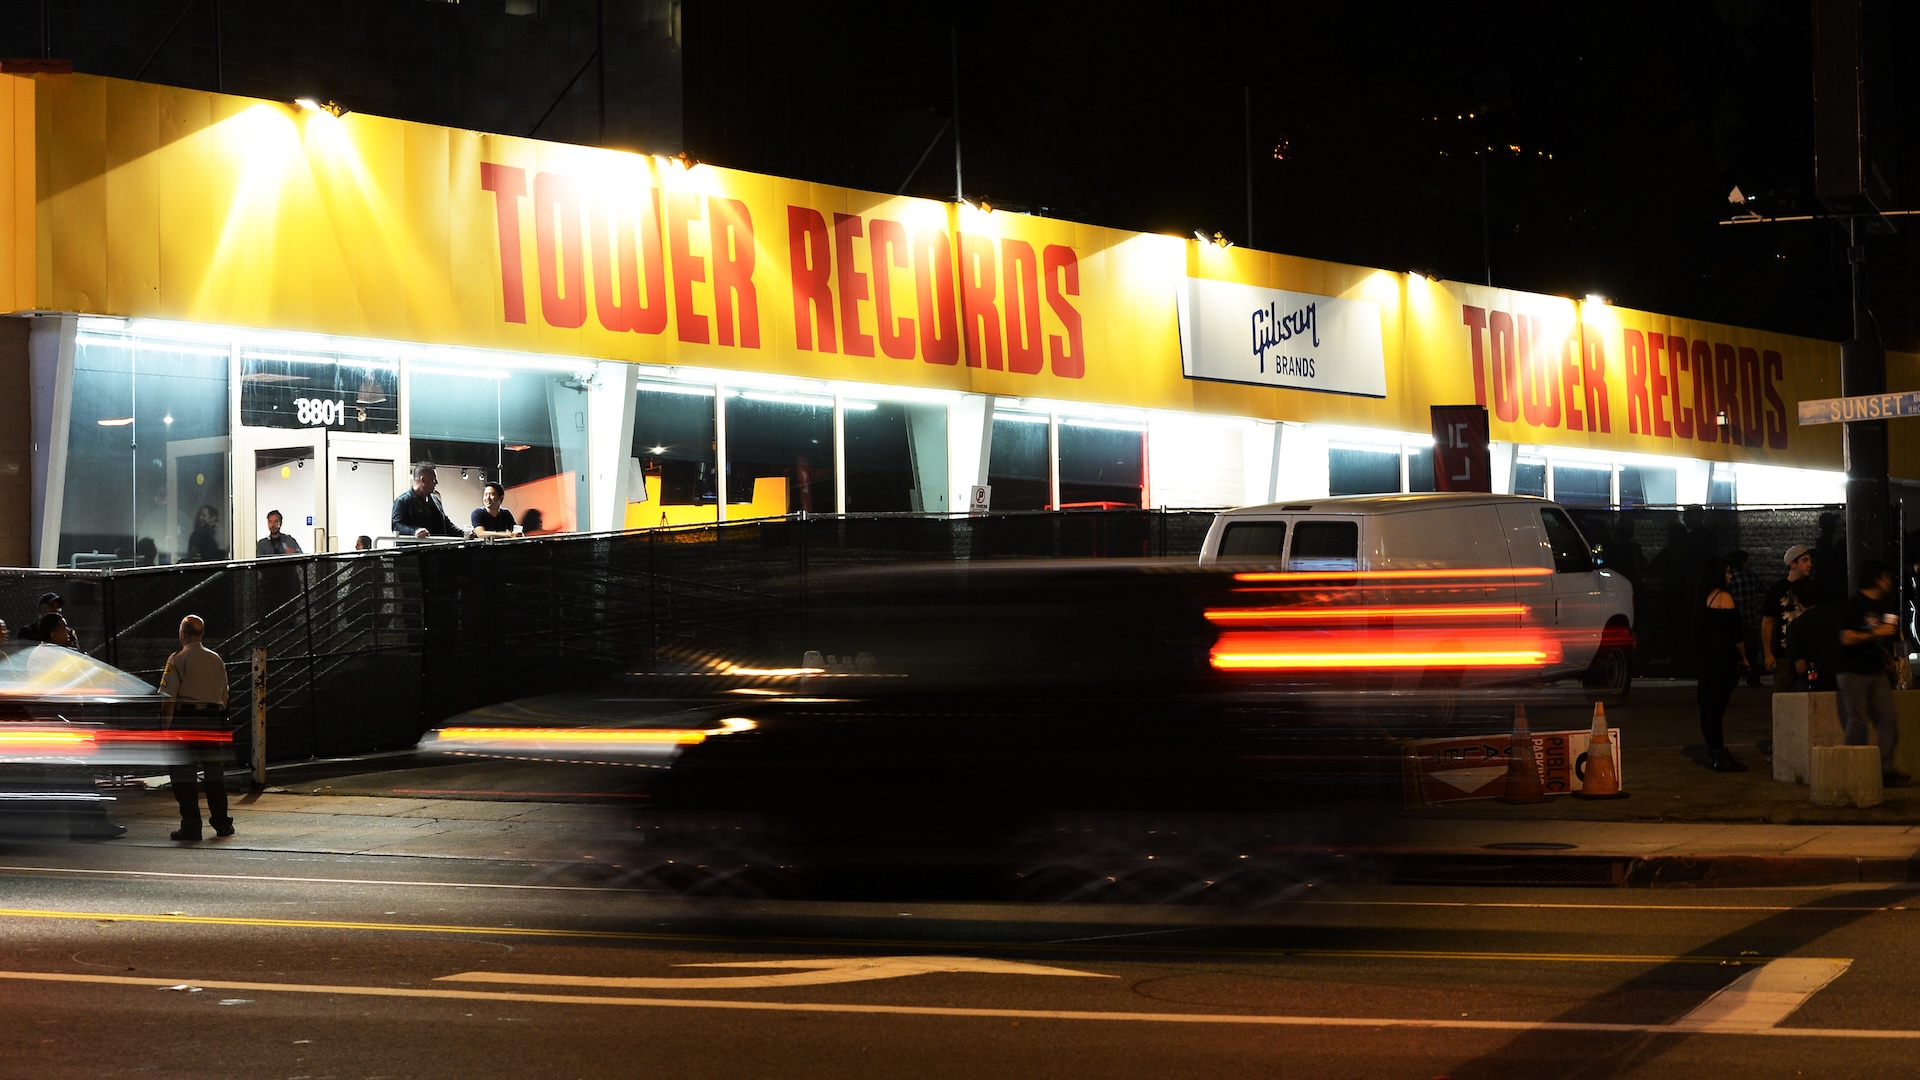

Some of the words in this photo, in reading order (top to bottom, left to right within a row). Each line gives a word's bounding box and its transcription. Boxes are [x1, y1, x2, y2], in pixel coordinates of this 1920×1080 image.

[480, 161, 761, 349] TOWER
[787, 205, 1085, 379] RECORDS
[1251, 301, 1320, 374] Gibson
[1276, 355, 1316, 378] BRANDS
[1462, 304, 1611, 433] TOWER
[1623, 328, 1788, 450] RECORDS
[297, 397, 345, 426] 8801
[1830, 395, 1903, 421] SUNSET
[1546, 737, 1565, 791] PUBLIC
